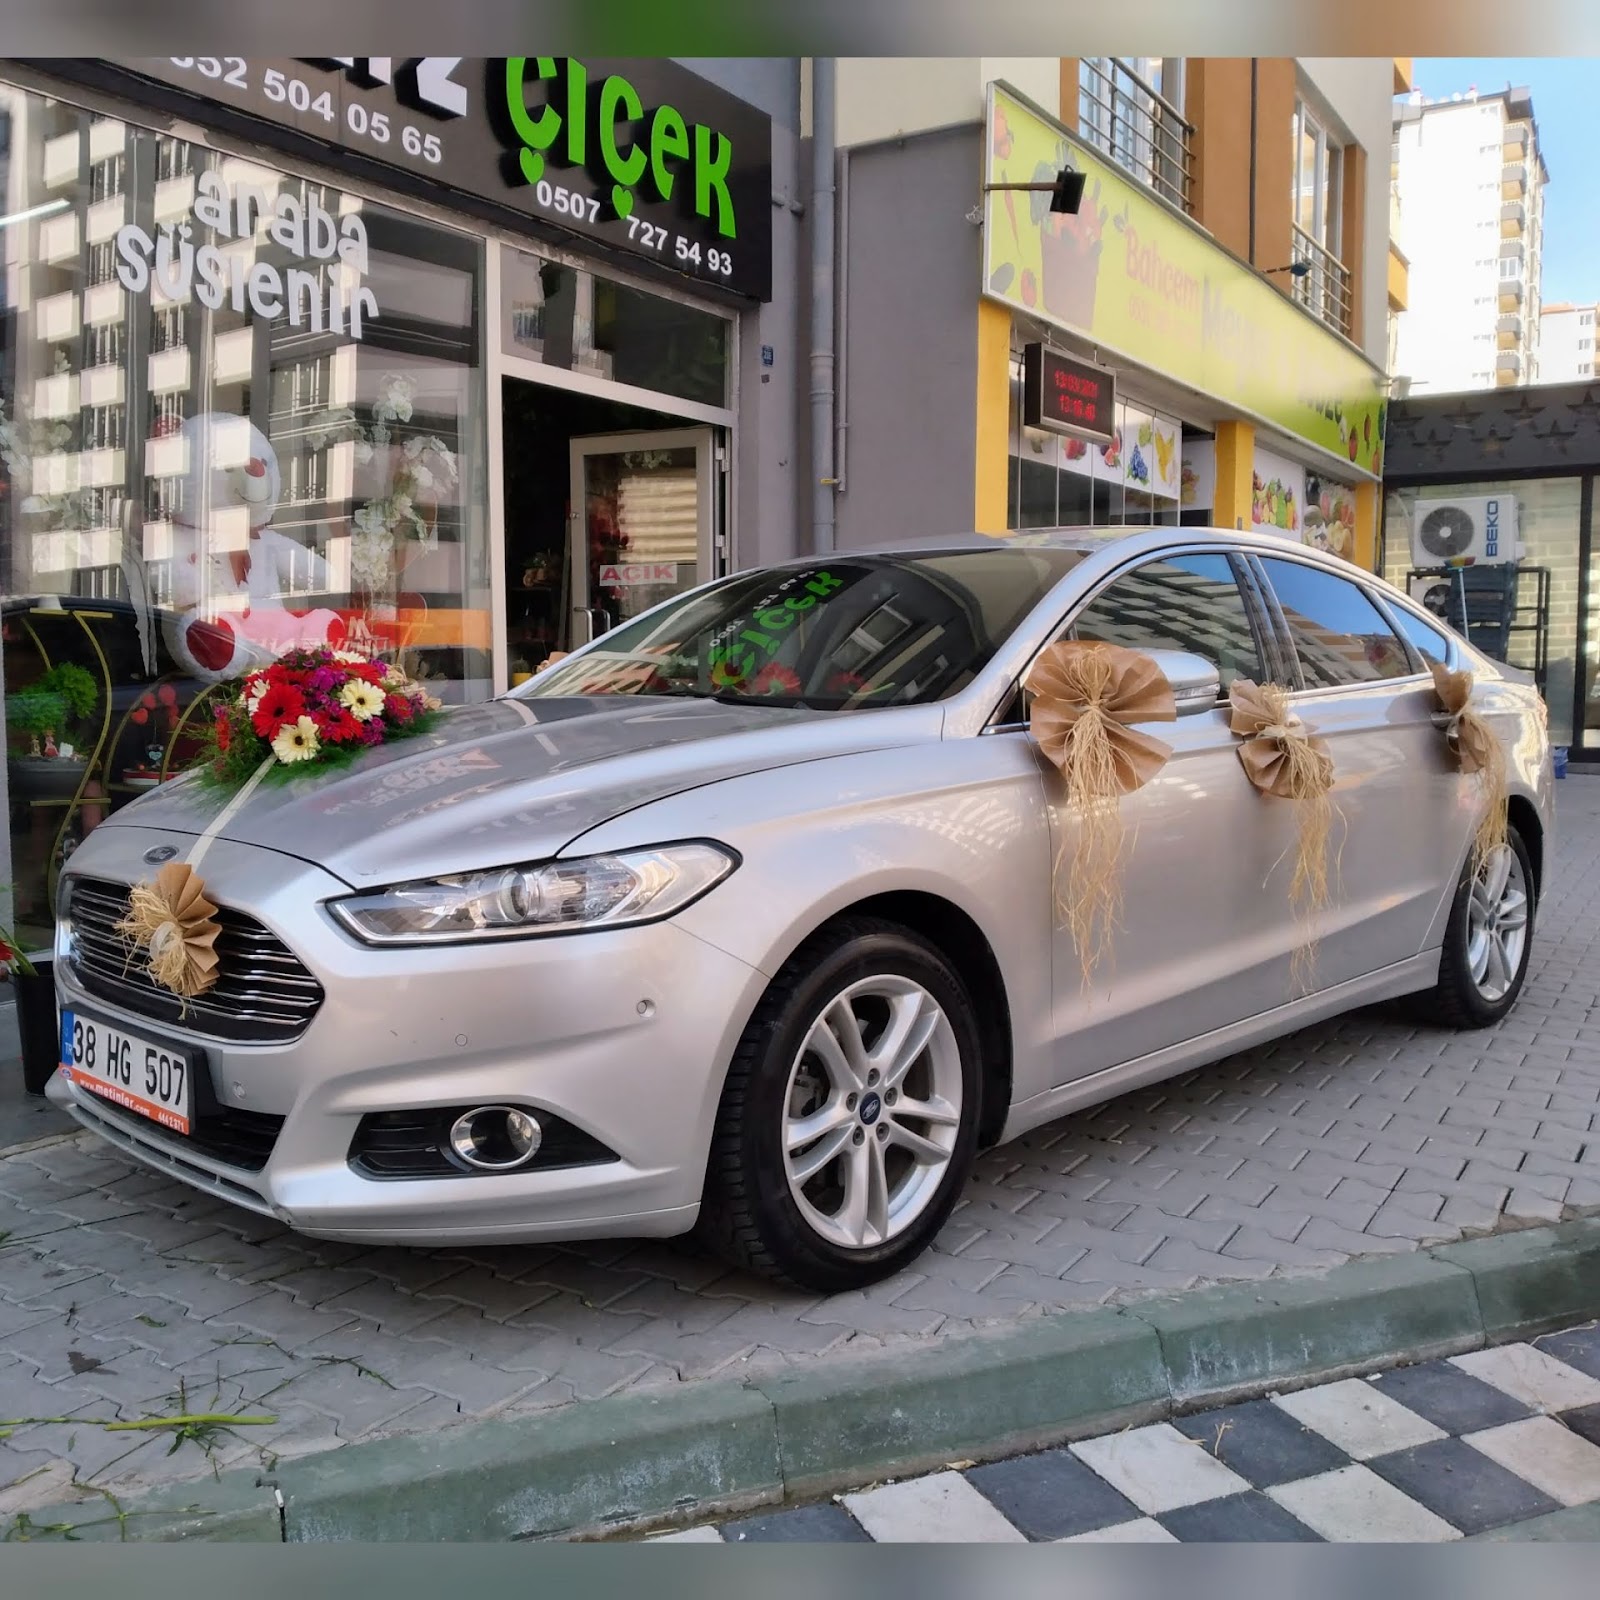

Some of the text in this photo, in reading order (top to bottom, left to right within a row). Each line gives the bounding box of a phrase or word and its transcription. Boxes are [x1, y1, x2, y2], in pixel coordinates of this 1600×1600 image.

[263, 68, 334, 122] 504
[347, 103, 391, 143] 05
[402, 126, 442, 163] 65
[194, 170, 369, 275] araba
[536, 180, 732, 275] 0507 727 54 93
[116, 223, 379, 340] süslenir
[1486, 501, 1499, 557] BEKO
[73, 1020, 185, 1106] 38 HG 507
